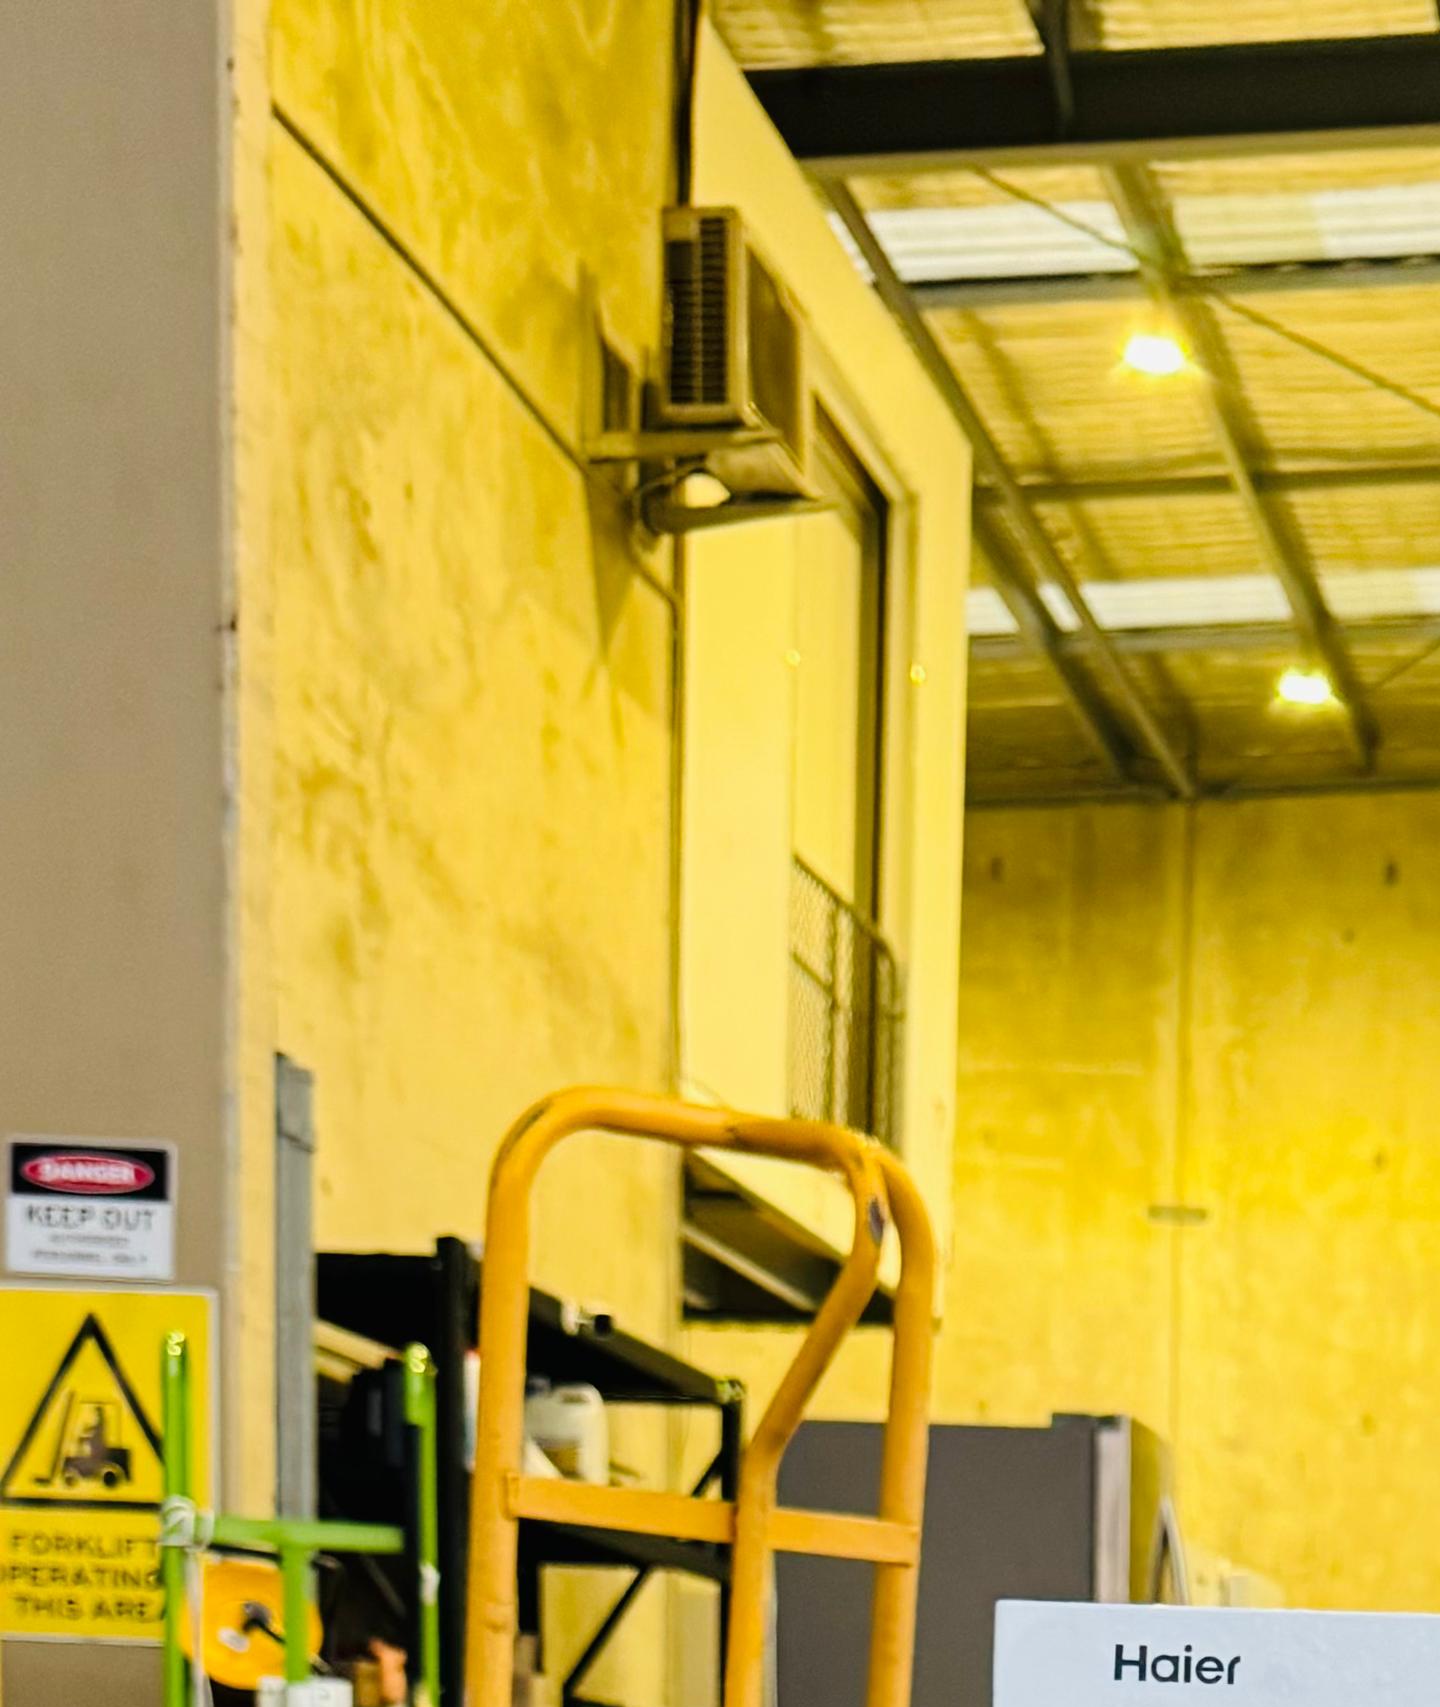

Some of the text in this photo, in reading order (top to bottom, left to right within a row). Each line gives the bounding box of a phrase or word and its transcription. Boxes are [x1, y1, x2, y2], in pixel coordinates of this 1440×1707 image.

[39, 1162, 136, 1185] DANGER
[27, 1205, 155, 1231] KEEP OUT
[12, 1534, 160, 1558] FORKLIFT
[14, 1595, 82, 1620] THIS
[1113, 1643, 1241, 1685] Haier
